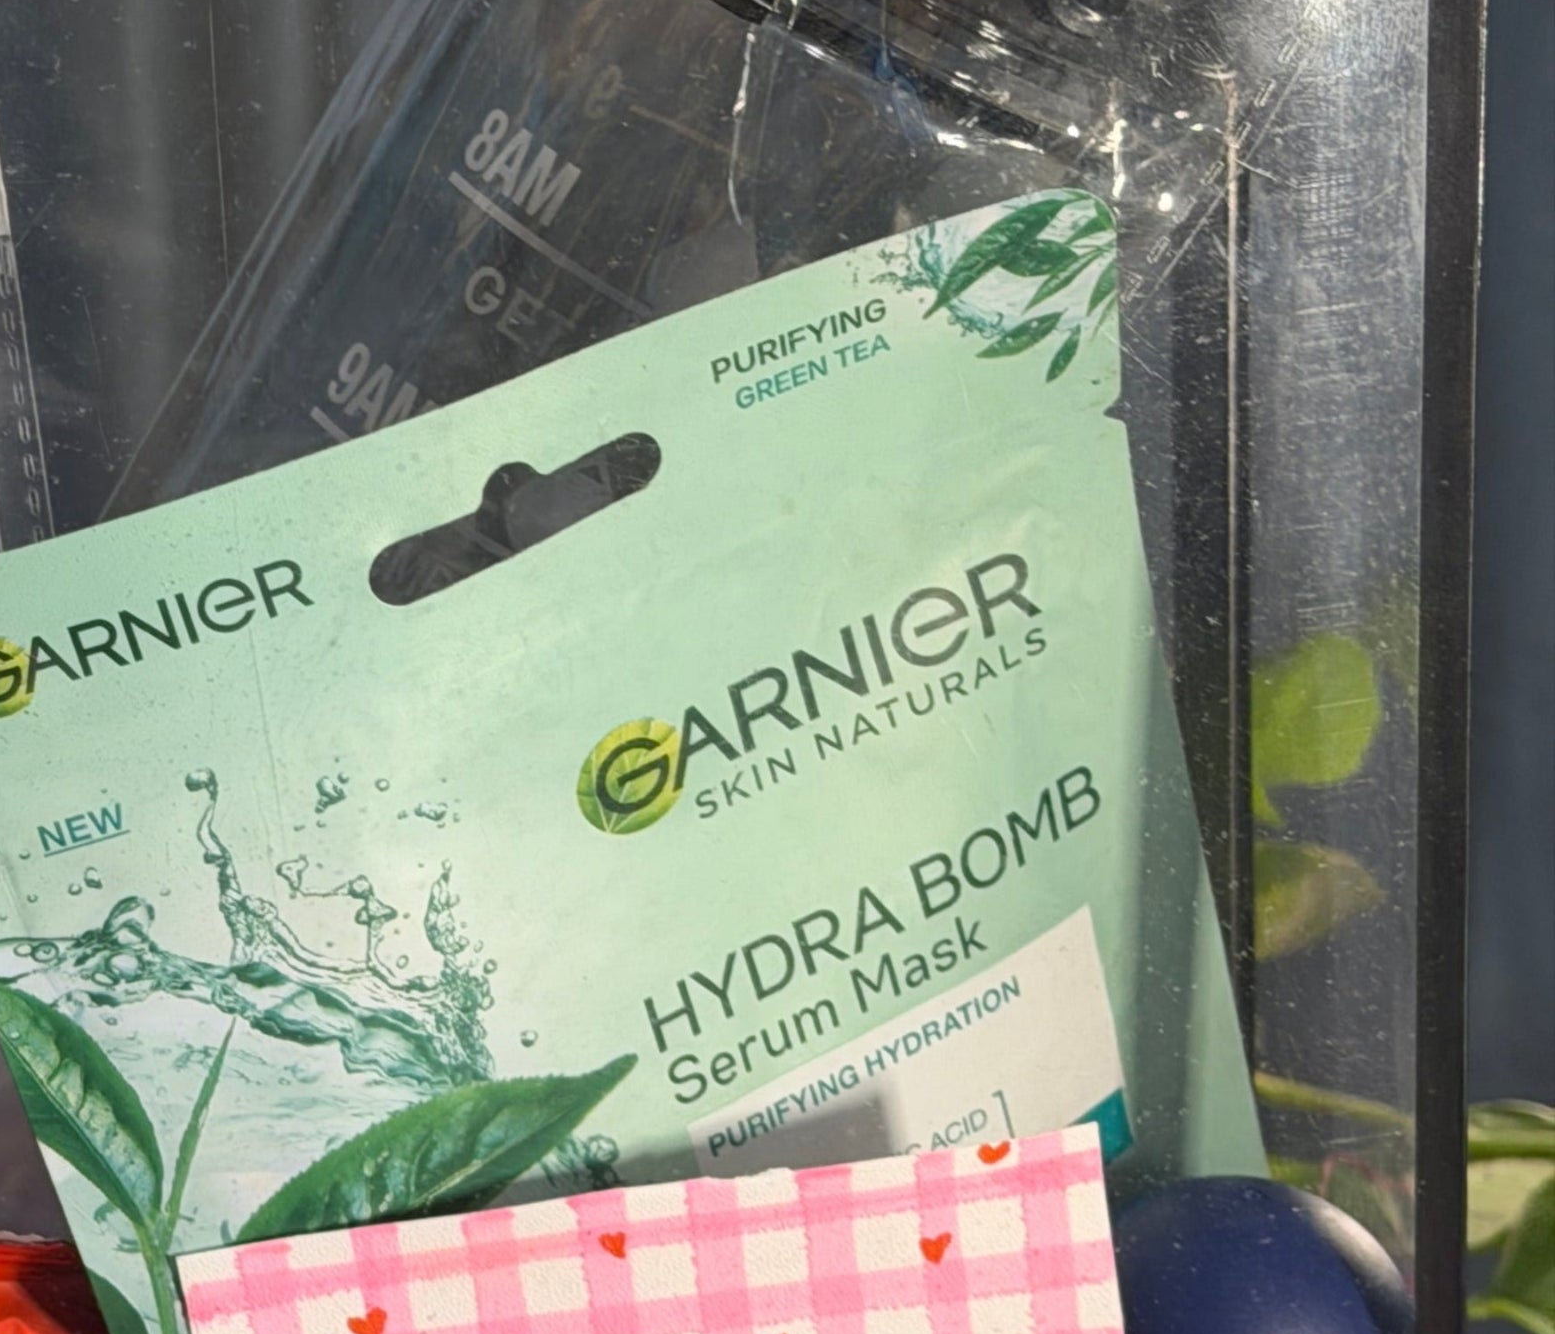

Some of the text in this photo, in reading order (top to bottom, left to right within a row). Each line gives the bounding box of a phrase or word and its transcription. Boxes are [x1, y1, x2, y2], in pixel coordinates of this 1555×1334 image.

[464, 109, 581, 227] 8AM
[710, 298, 888, 383] PURIFYING
[734, 333, 891, 410] GREEN TEA
[595, 553, 1043, 815] GARNIER
[694, 626, 1049, 821] SKIN NATURALS
[37, 803, 125, 853] NEW
[644, 765, 1104, 1053] HYDRA BOMB
[667, 917, 988, 1106] Serum Mask
[707, 976, 1022, 1158] PURIFYING HYDRATION
[930, 1108, 988, 1151] ACID
